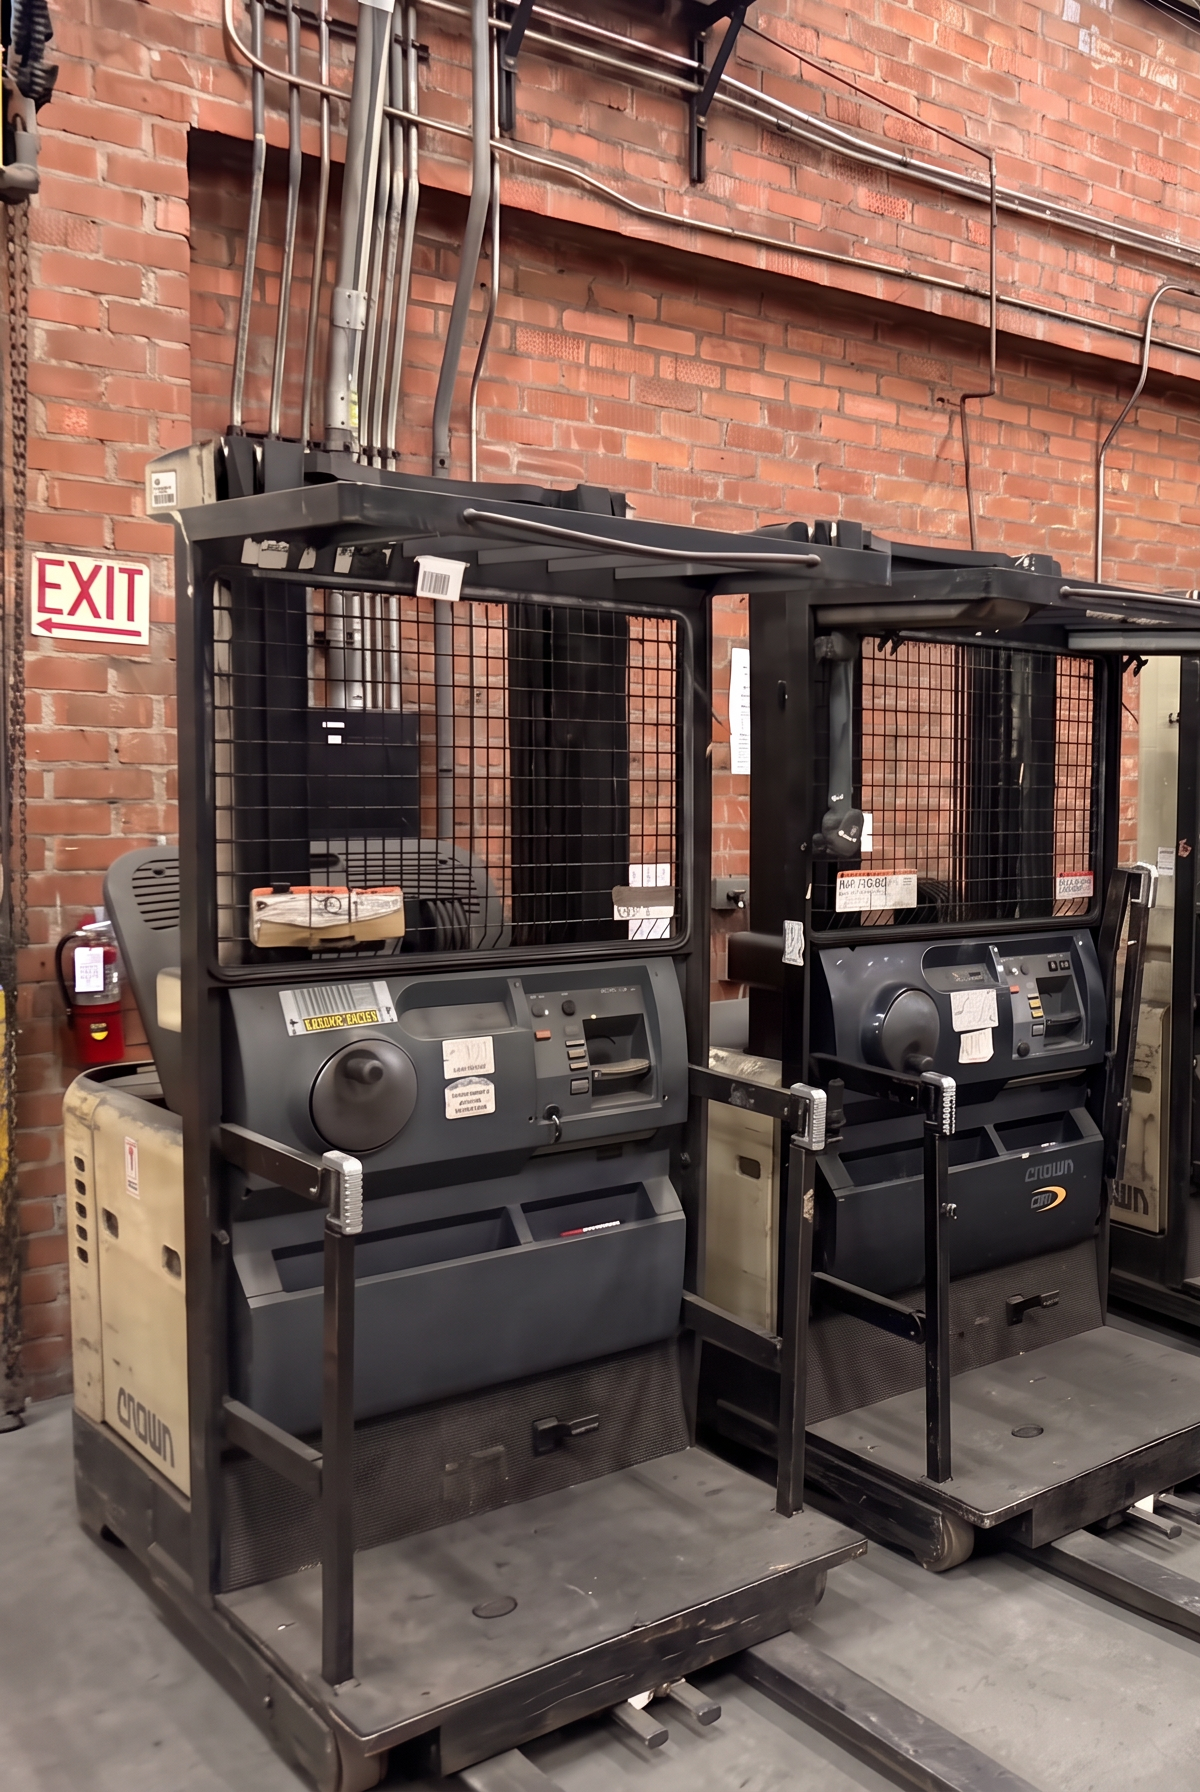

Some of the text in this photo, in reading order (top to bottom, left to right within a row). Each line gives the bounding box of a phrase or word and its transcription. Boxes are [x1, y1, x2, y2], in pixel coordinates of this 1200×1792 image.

[37, 557, 143, 622] EXIT
[1024, 1159, 1074, 1183] CROWN
[117, 1386, 175, 1469] CROWN
